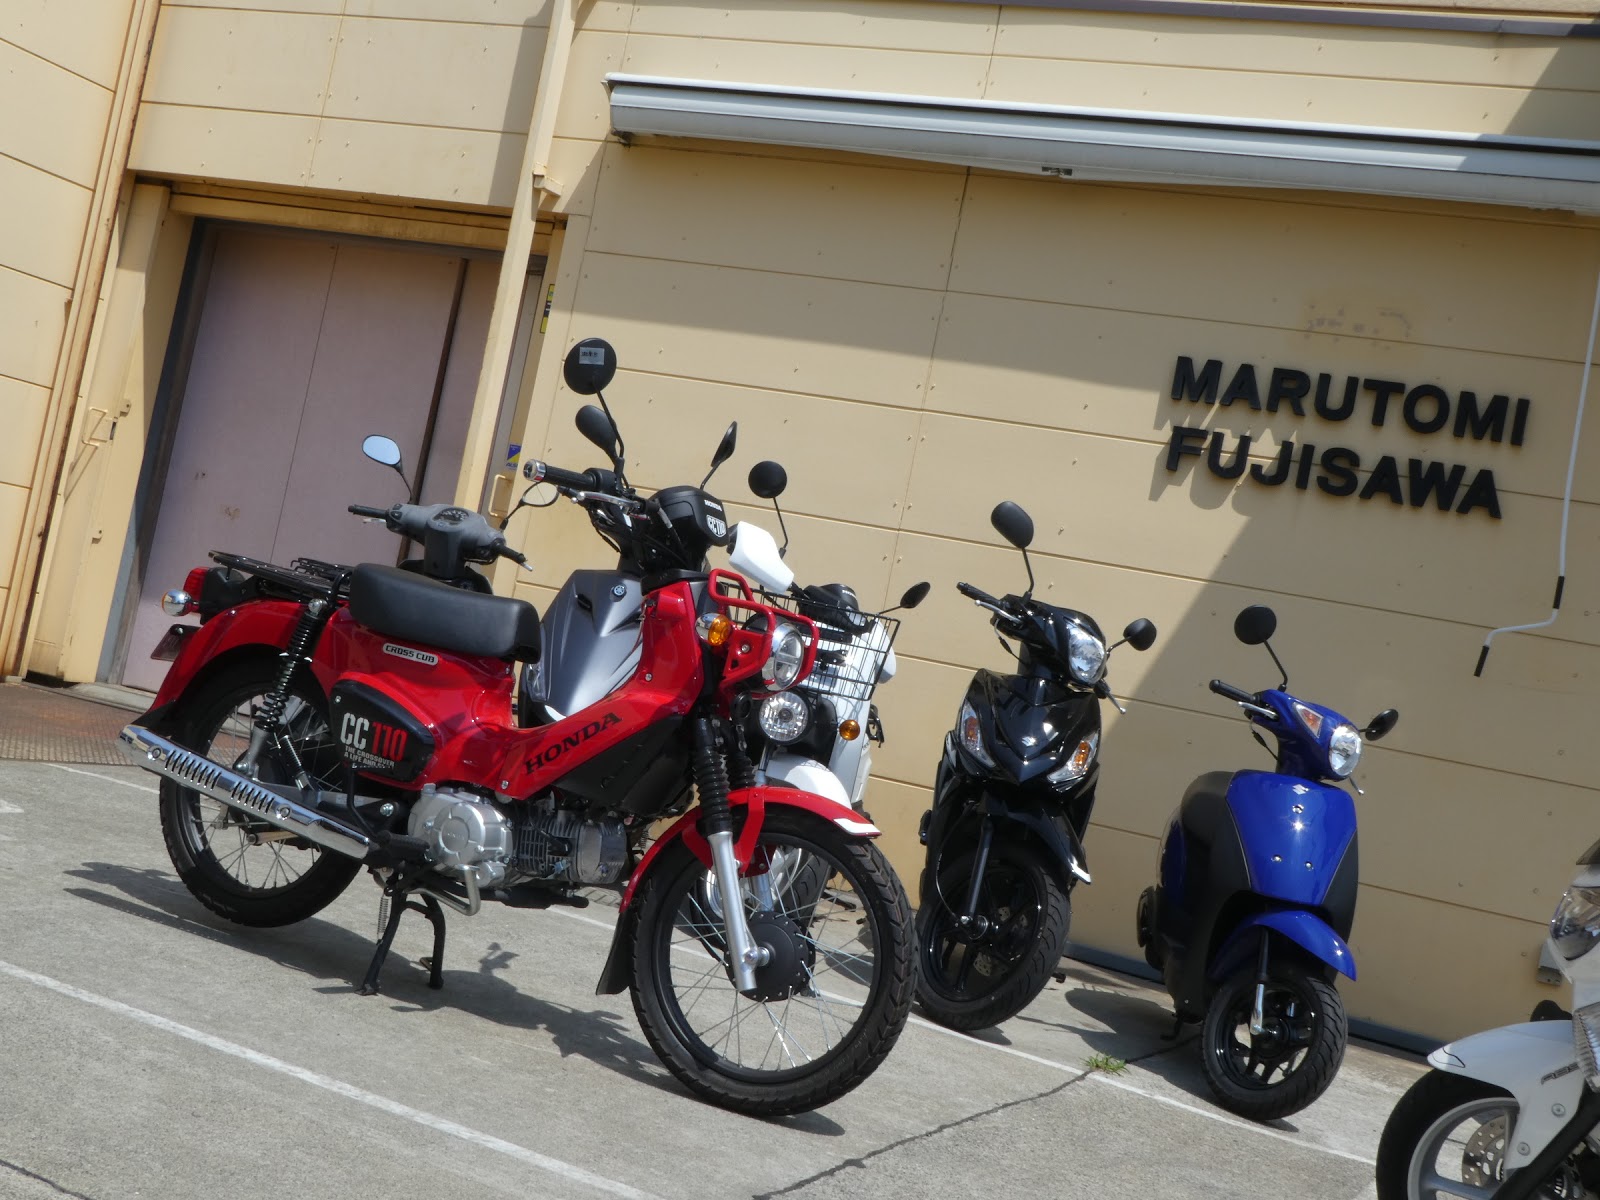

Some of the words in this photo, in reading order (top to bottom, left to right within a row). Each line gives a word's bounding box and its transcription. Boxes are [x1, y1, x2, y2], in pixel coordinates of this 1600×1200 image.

[1170, 355, 1530, 447] MARUTOMI
[1165, 425, 1502, 519] FUJISAWA
[385, 644, 415, 658] CROSS
[415, 652, 435, 663] CUB
[340, 712, 370, 750] CC
[372, 721, 408, 763] 110
[345, 745, 356, 754] THE
[356, 750, 395, 767] CROSSOVER
[349, 753, 362, 763] LIFE
[524, 712, 622, 775] HONDA
